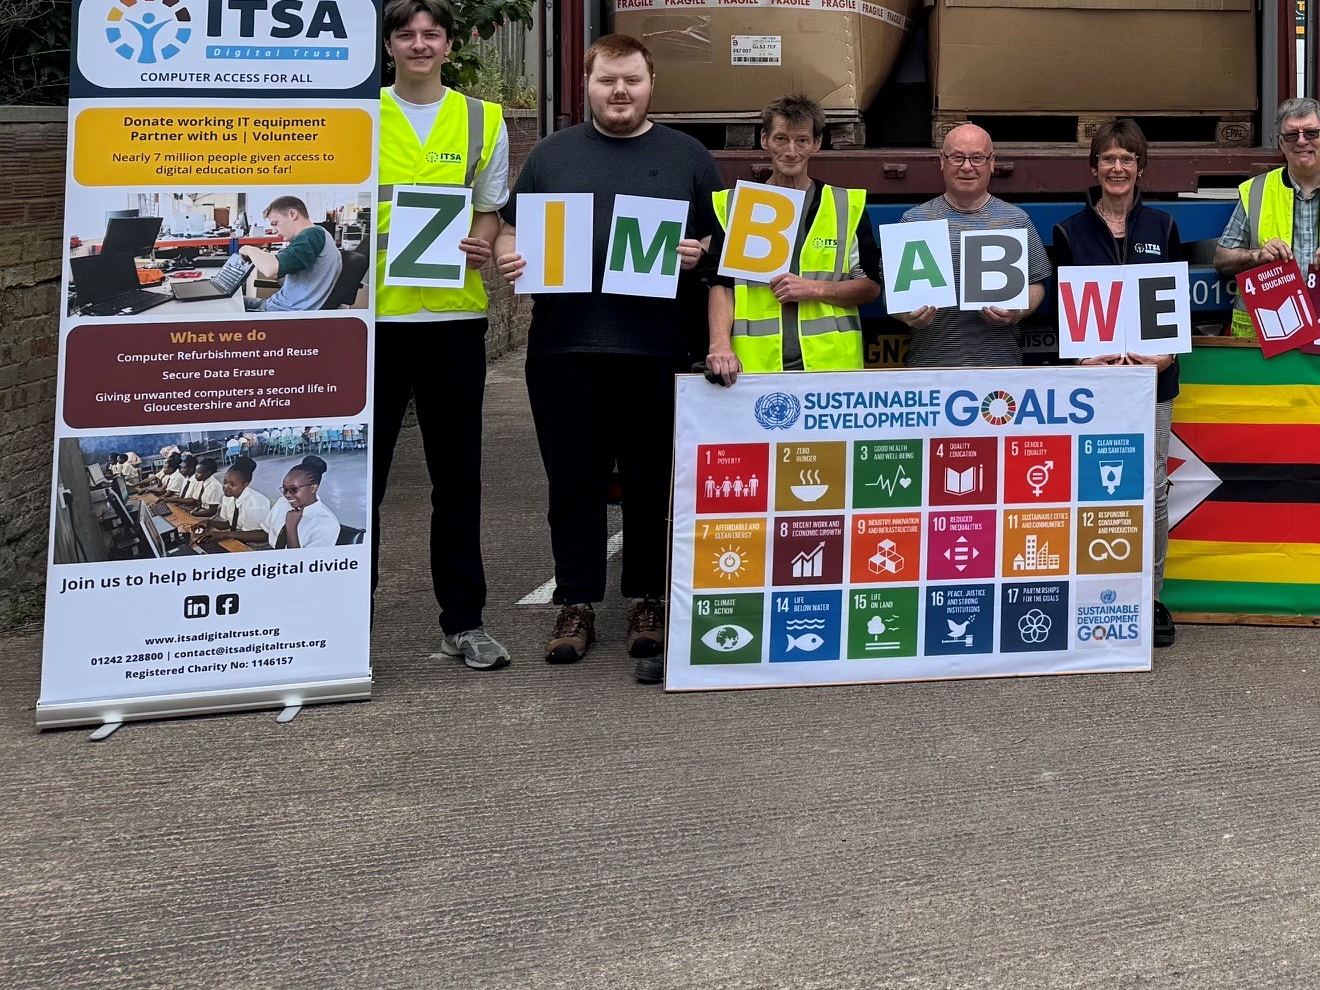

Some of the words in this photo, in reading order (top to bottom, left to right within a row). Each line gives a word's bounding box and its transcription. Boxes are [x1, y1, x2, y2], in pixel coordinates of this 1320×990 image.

[862, 3, 883, 18] FRAGILE
[214, 48, 280, 58] Digital
[294, 50, 341, 58] Trust
[140, 72, 210, 83] COMPUTER
[214, 73, 260, 83] ACCESS
[264, 74, 287, 83] FOR
[291, 74, 313, 83] ALL
[124, 116, 173, 127] Donate
[177, 118, 234, 129] working
[238, 118, 250, 127] IT
[254, 118, 326, 130] equipment
[131, 131, 185, 141] Partner
[187, 131, 219, 141] with
[223, 133, 238, 141] us
[252, 131, 318, 141] Volunteer
[1225, 128, 1245, 138] EPAL
[112, 152, 151, 165] Nearly
[154, 153, 160, 162] 7
[164, 153, 204, 162] million
[208, 153, 248, 165] people
[251, 153, 281, 165] given
[284, 153, 320, 161] access
[322, 153, 334, 161] to
[156, 165, 192, 176] digital
[195, 165, 253, 175] education
[273, 165, 292, 174] far!
[389, 192, 465, 280] Z
[723, 186, 796, 272] B
[544, 201, 565, 286] I
[609, 217, 682, 275] M
[824, 238, 837, 246] ITS
[893, 240, 947, 292] A
[964, 235, 1025, 303] B
[1258, 266, 1283, 281] QUALITY
[1307, 273, 1316, 288] 8
[1245, 278, 1256, 295] 4
[1262, 273, 1296, 291] EDUCATION
[1192, 280, 1237, 304] 019
[1058, 281, 1123, 342] W
[1138, 276, 1178, 340] E
[170, 331, 214, 344] What
[219, 331, 243, 342] we
[247, 330, 267, 342] do
[117, 351, 174, 364] Computer
[178, 349, 260, 361] Refurbishment
[263, 348, 284, 358] and
[287, 347, 319, 357] Reuse
[162, 369, 200, 380] Secure
[204, 368, 229, 379] Data
[233, 367, 275, 378] Erasure
[95, 390, 131, 404] Giving
[134, 389, 191, 401] unwanted
[194, 387, 254, 401] computers
[267, 384, 304, 396] second
[307, 384, 324, 394] life
[327, 384, 337, 393] in
[804, 390, 940, 410] SUSTAINABLE
[144, 400, 233, 413] Gloucestershire
[235, 399, 256, 409] and
[259, 398, 291, 408] Africa
[945, 388, 1094, 426] GOALS
[804, 411, 940, 430] DEVELOPMENT
[860, 446, 868, 460] 3
[936, 444, 944, 457] 4
[950, 450, 976, 458] EDUCATION
[1011, 442, 1018, 456] 5
[1024, 448, 1047, 456] EQUALITY
[1084, 440, 1092, 454] 6
[706, 450, 711, 464] 1
[783, 448, 790, 462] 2
[933, 517, 946, 531] 10
[1008, 514, 1018, 529] 11
[1022, 513, 1054, 521] SUSTAINABLE
[1082, 512, 1093, 527] 12
[703, 525, 709, 539] 7
[715, 524, 748, 532] AFFORDABLE
[780, 523, 788, 537] 8
[793, 521, 812, 529] DECENT
[858, 520, 865, 534] 9
[820, 529, 841, 537] GROWTH
[60, 577, 95, 594] Join
[100, 575, 120, 588] us
[126, 574, 143, 586] to
[149, 571, 187, 586] help
[193, 566, 246, 585] bridge
[250, 561, 303, 579] digital
[308, 558, 358, 573] divide
[854, 594, 866, 609] 15
[931, 591, 943, 605] 16
[1008, 588, 1019, 603] 17
[1043, 594, 1059, 602] GOALS
[697, 600, 710, 615] 13
[777, 597, 789, 612] 14
[812, 603, 829, 611] WATER
[1078, 605, 1139, 615] SUSTAINABLE
[1077, 614, 1138, 624] DEVELOPMENT
[145, 626, 280, 646] www.itsadigitaltrust.org
[1077, 624, 1138, 641] GOALS
[91, 655, 122, 666] 01242
[126, 652, 163, 663] 228800
[175, 639, 326, 659] contact@itsadigitaltrust.org
[126, 666, 184, 680] Registered
[187, 662, 227, 675] Charity
[230, 661, 249, 670] No:
[251, 656, 293, 668] 1146157
